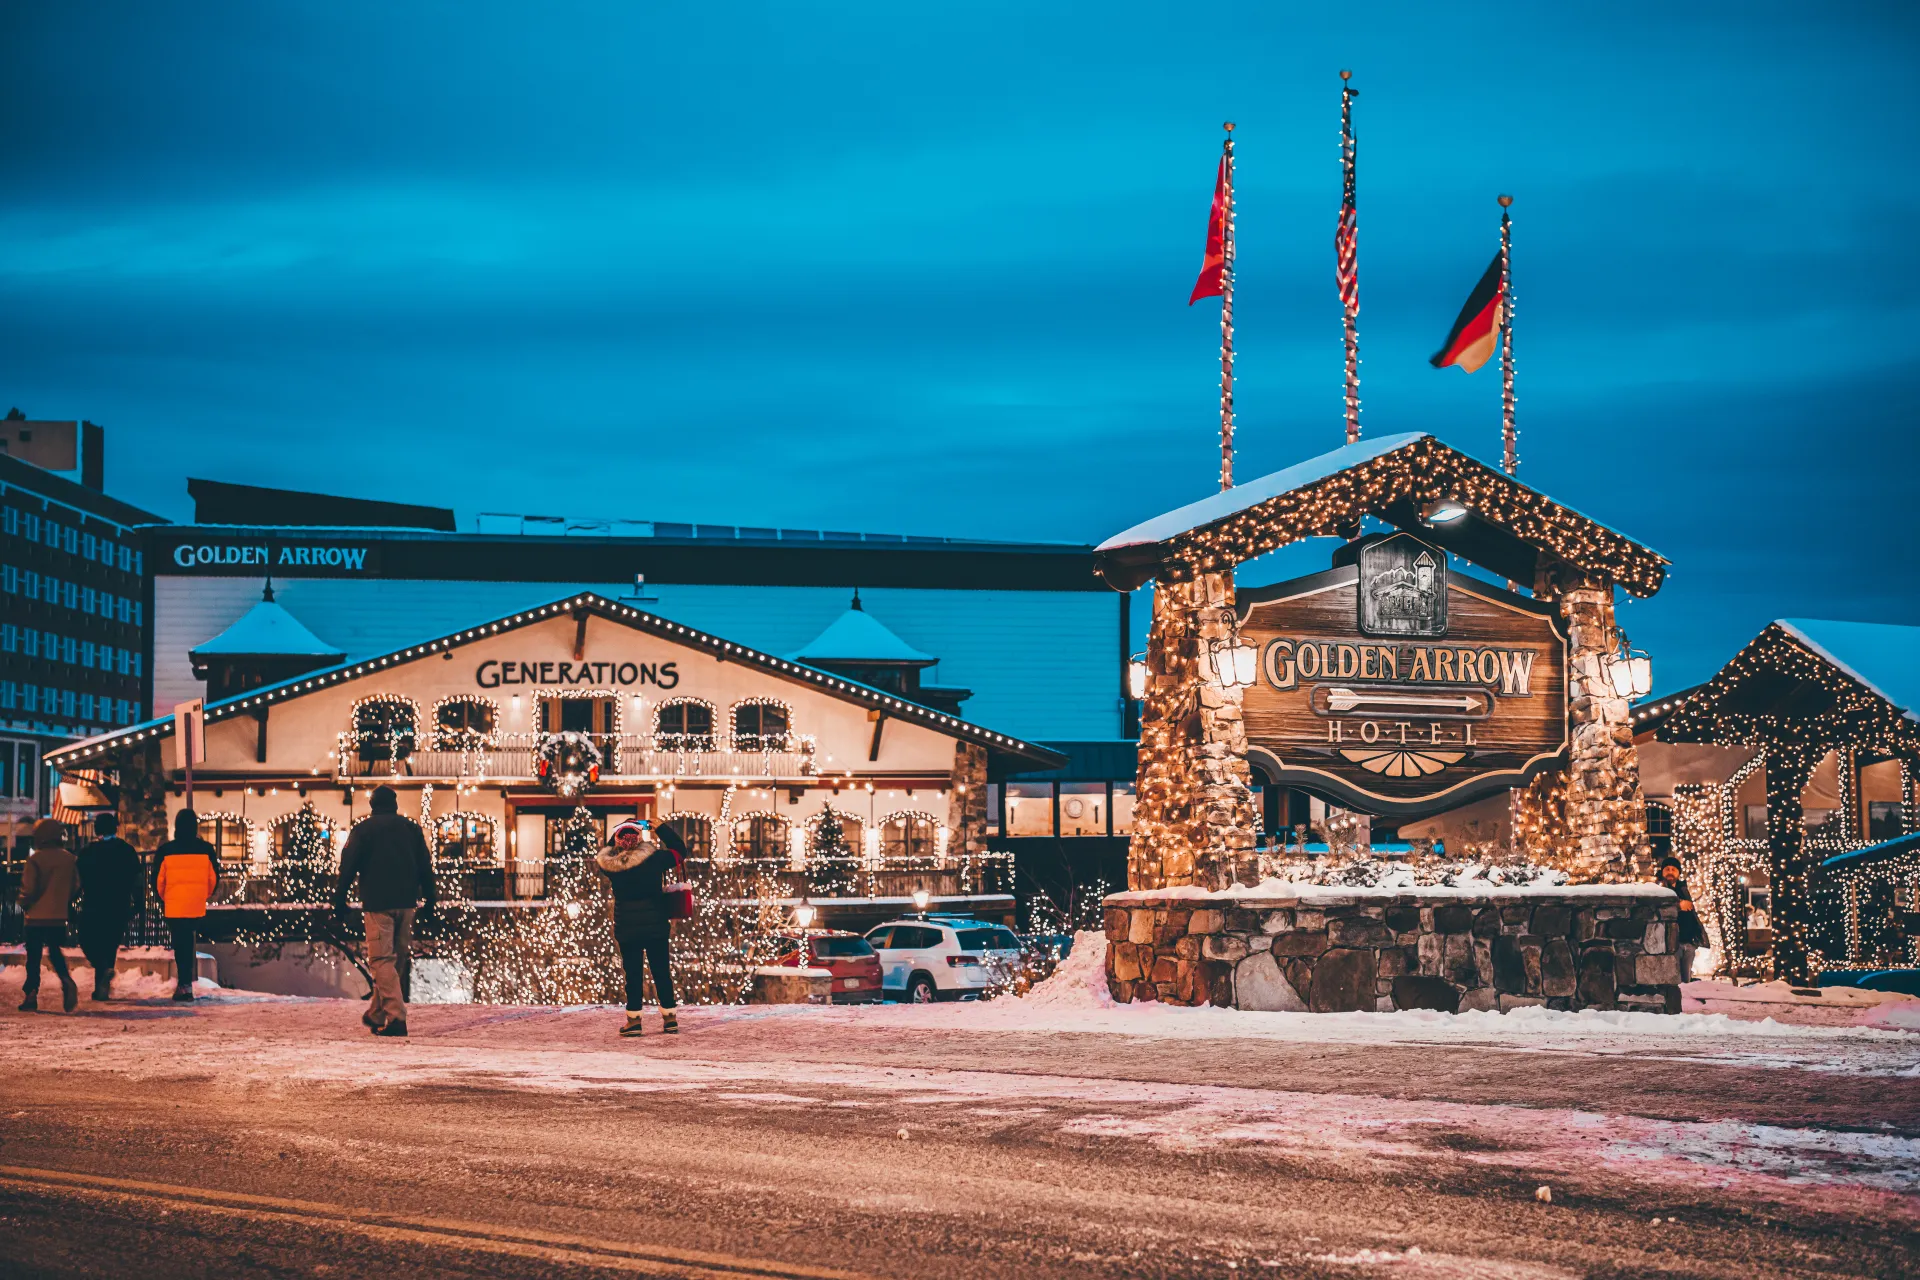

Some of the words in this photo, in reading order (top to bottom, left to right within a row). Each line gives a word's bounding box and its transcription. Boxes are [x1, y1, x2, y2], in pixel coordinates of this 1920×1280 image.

[173, 544, 269, 567] GOLDEN
[278, 547, 367, 570] ARROW
[476, 659, 680, 690] GENERATIONS
[1264, 638, 1399, 690] GOLDEN
[1408, 646, 1538, 696] ARROW
